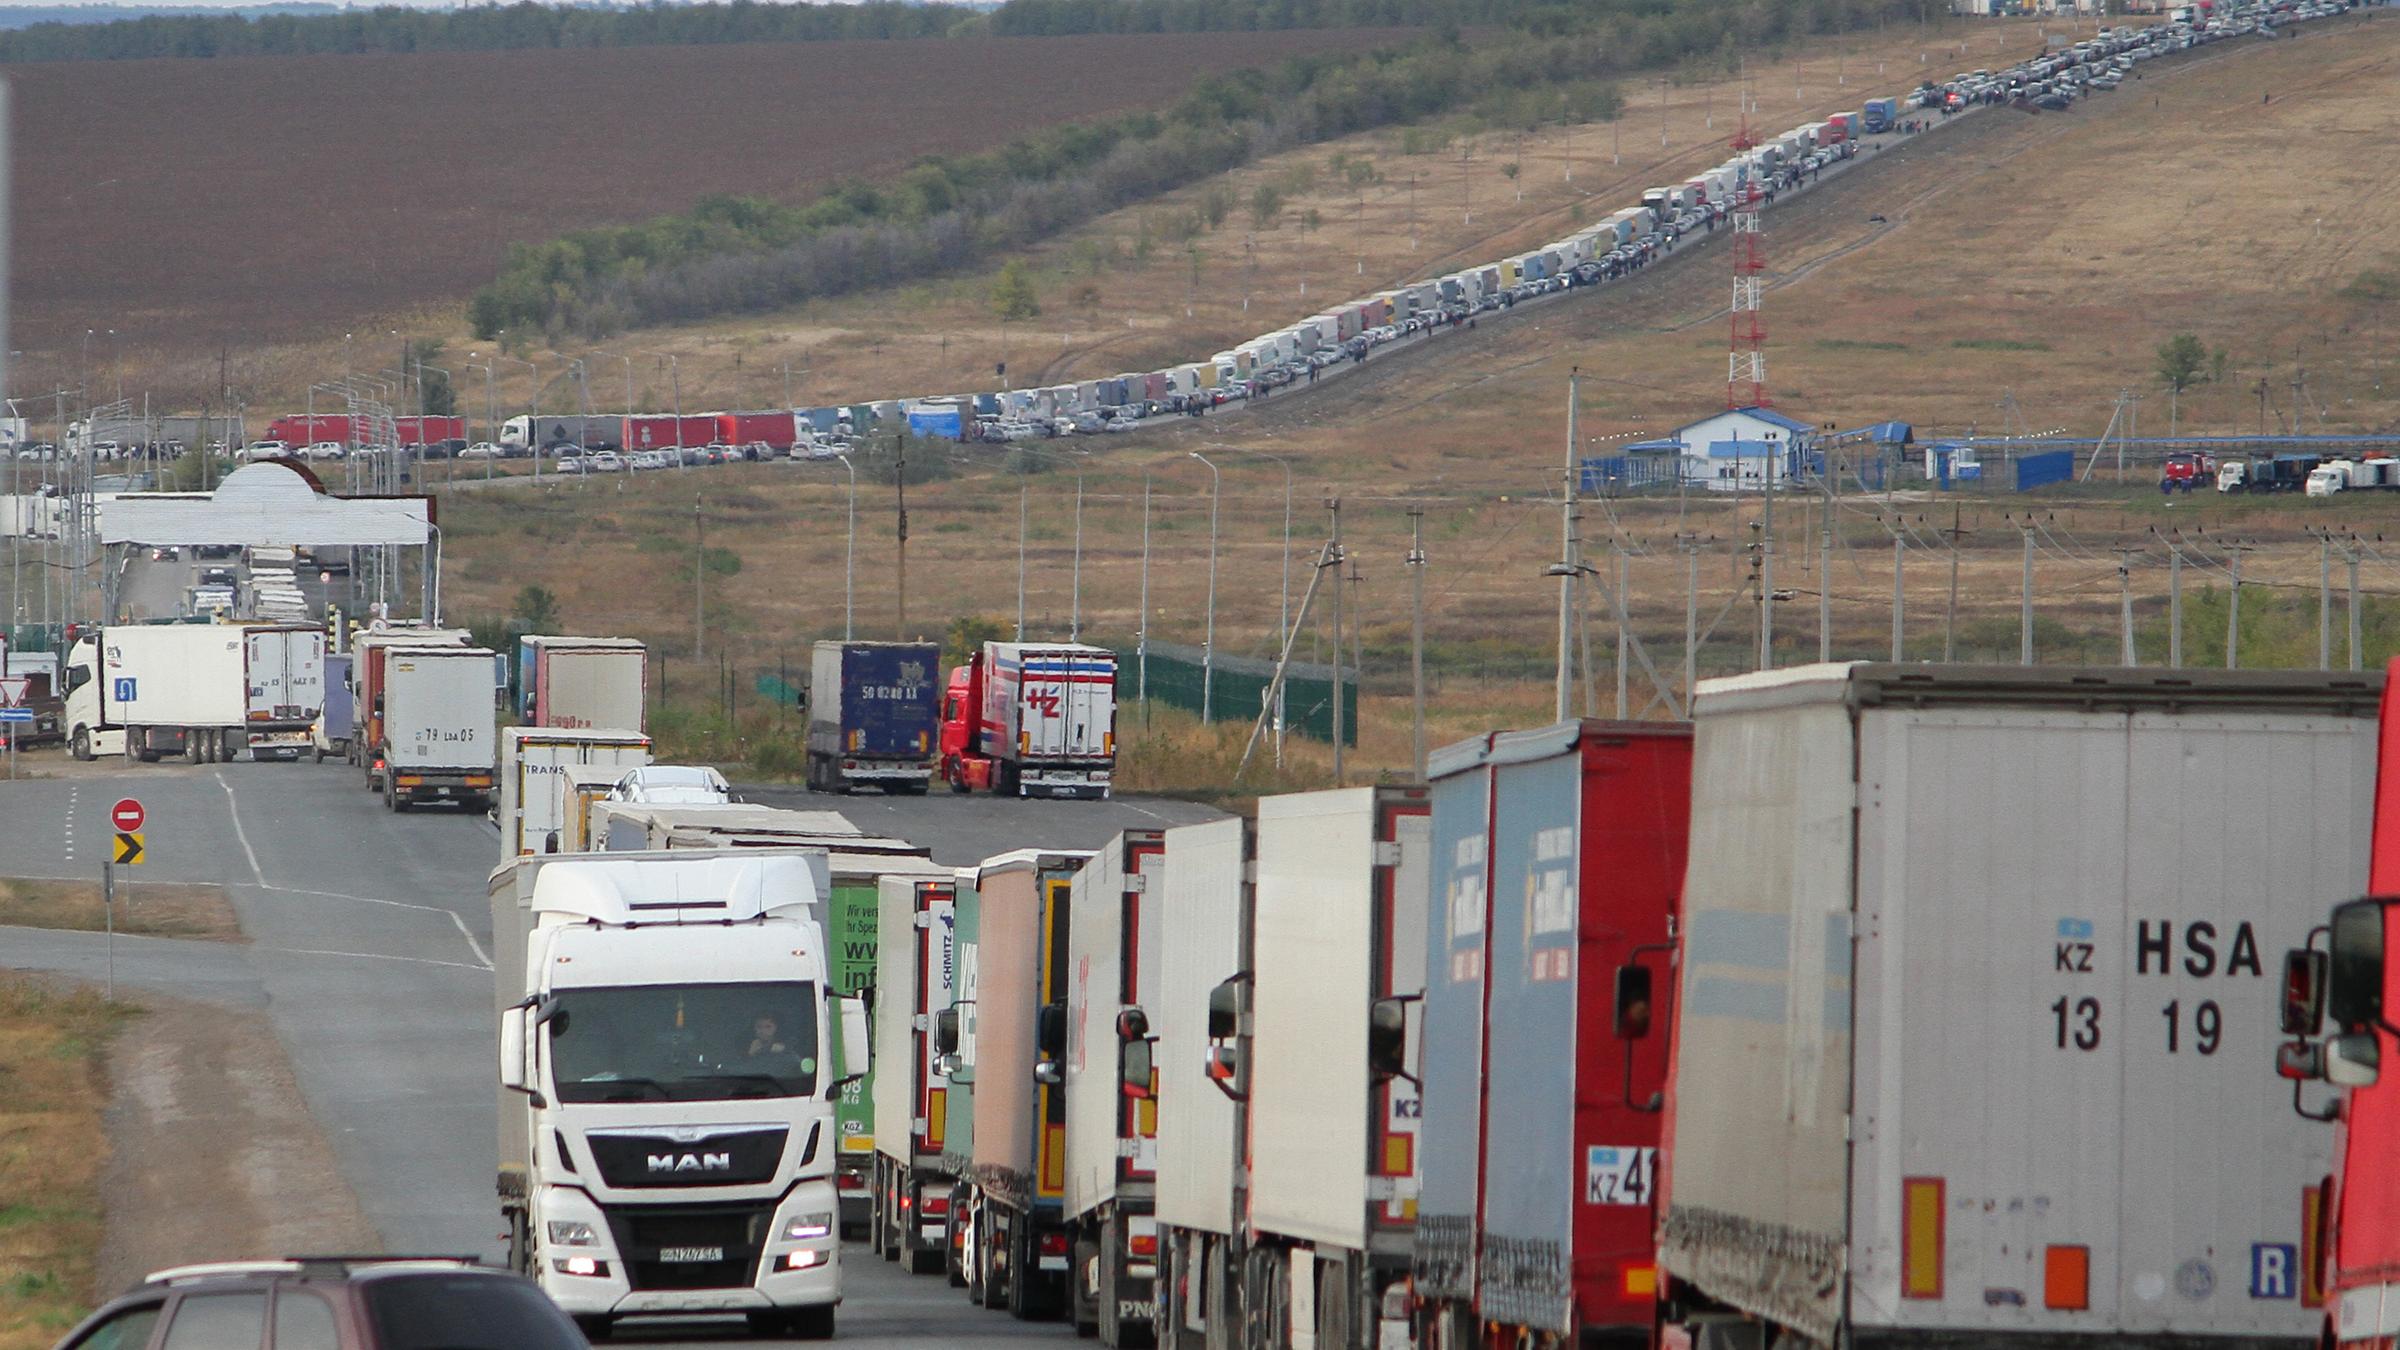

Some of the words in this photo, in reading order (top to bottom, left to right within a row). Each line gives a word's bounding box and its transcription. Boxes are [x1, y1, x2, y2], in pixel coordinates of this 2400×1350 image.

[425, 728, 438, 741] 79
[460, 728, 474, 742] 05
[526, 764, 565, 775] TRANS
[943, 934, 952, 990] SCHMITZ
[2056, 942, 2094, 972] KZ
[2137, 919, 2263, 978] HSA
[2051, 995, 2102, 1051] 13
[2163, 999, 2223, 1055] 19
[647, 1152, 730, 1172] MAN
[1590, 1173, 1618, 1202] KZ
[2260, 1247, 2286, 1295] R
